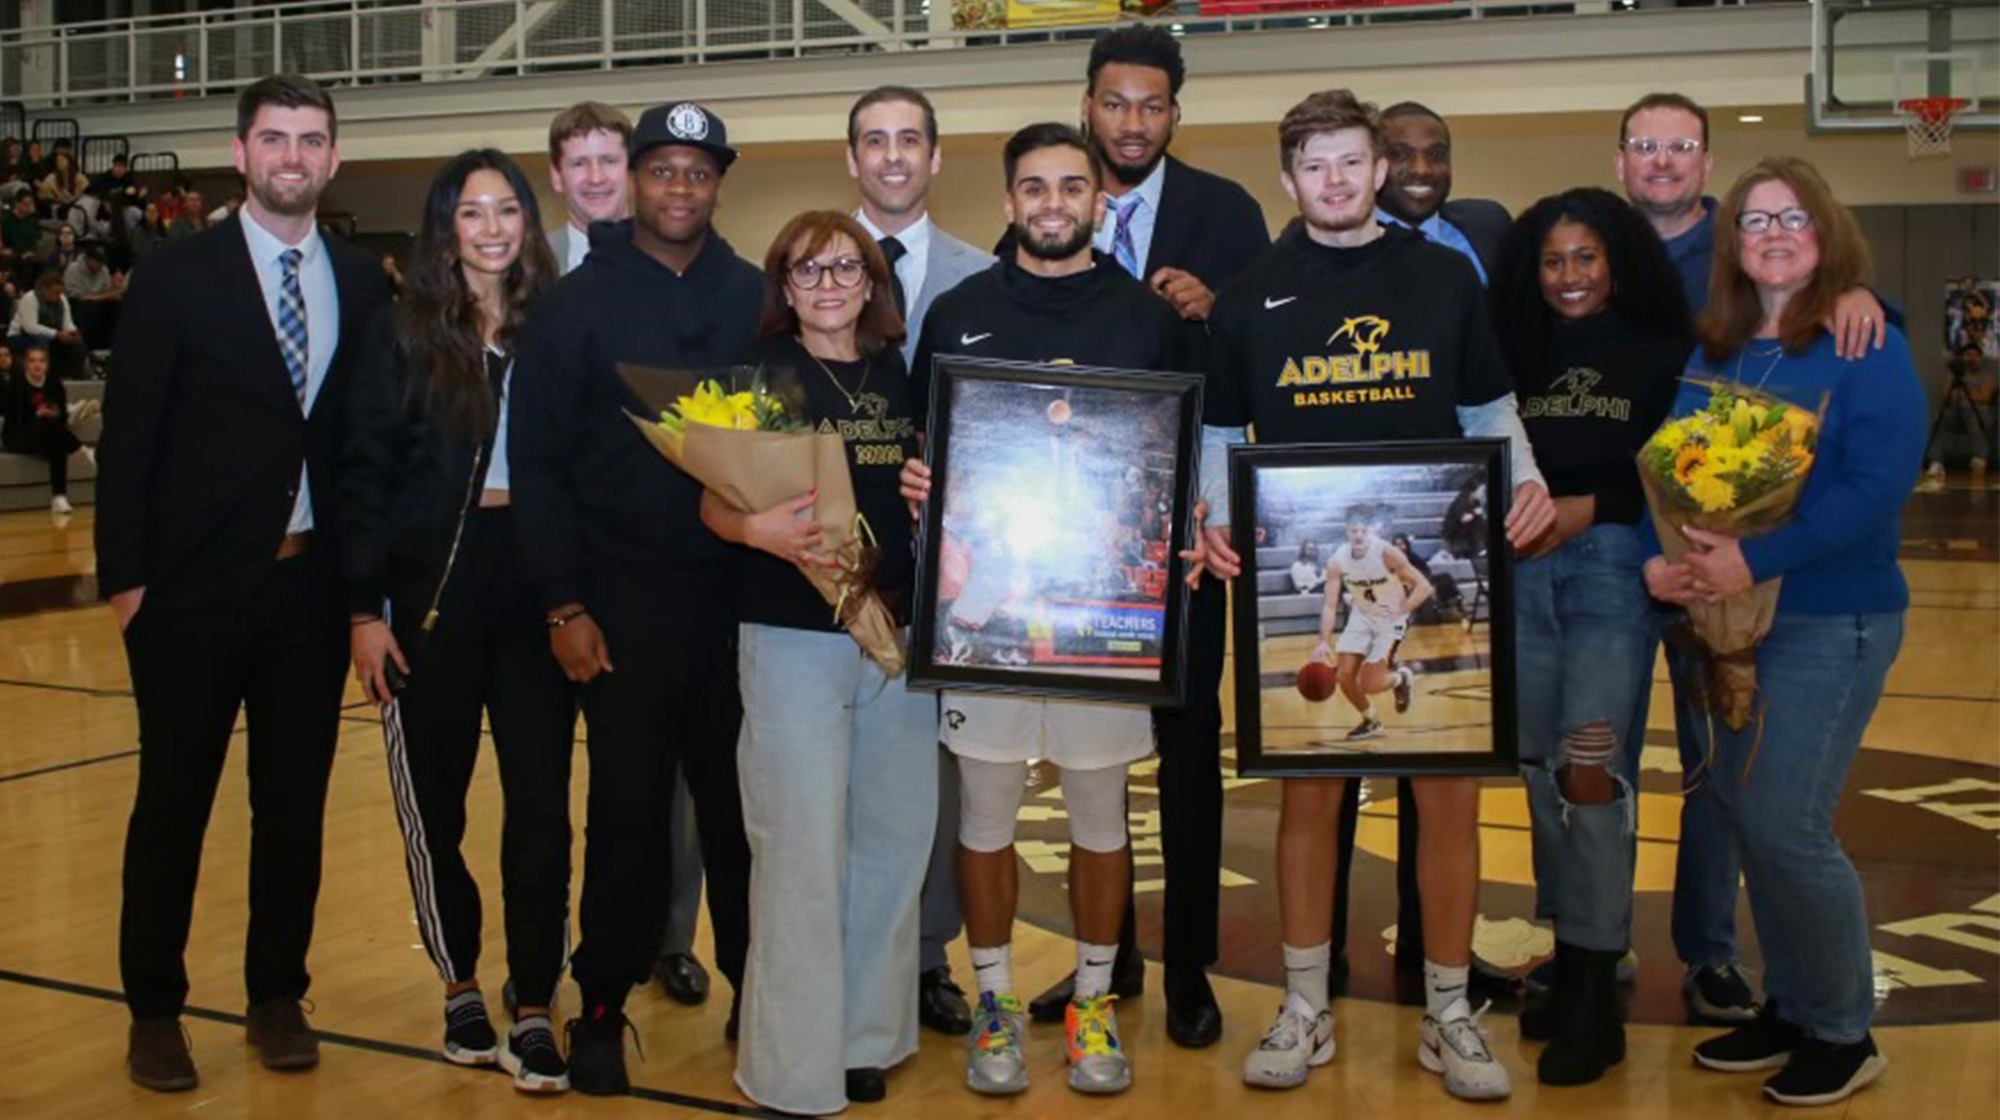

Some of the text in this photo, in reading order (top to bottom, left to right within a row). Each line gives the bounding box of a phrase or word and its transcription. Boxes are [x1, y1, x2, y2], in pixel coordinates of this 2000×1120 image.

[683, 113, 695, 131] B
[1276, 349, 1431, 387] ADELPHI
[1293, 386, 1416, 407] BASKETBALL
[1520, 395, 1631, 421] DELPHI
[1363, 588, 1377, 604] 4
